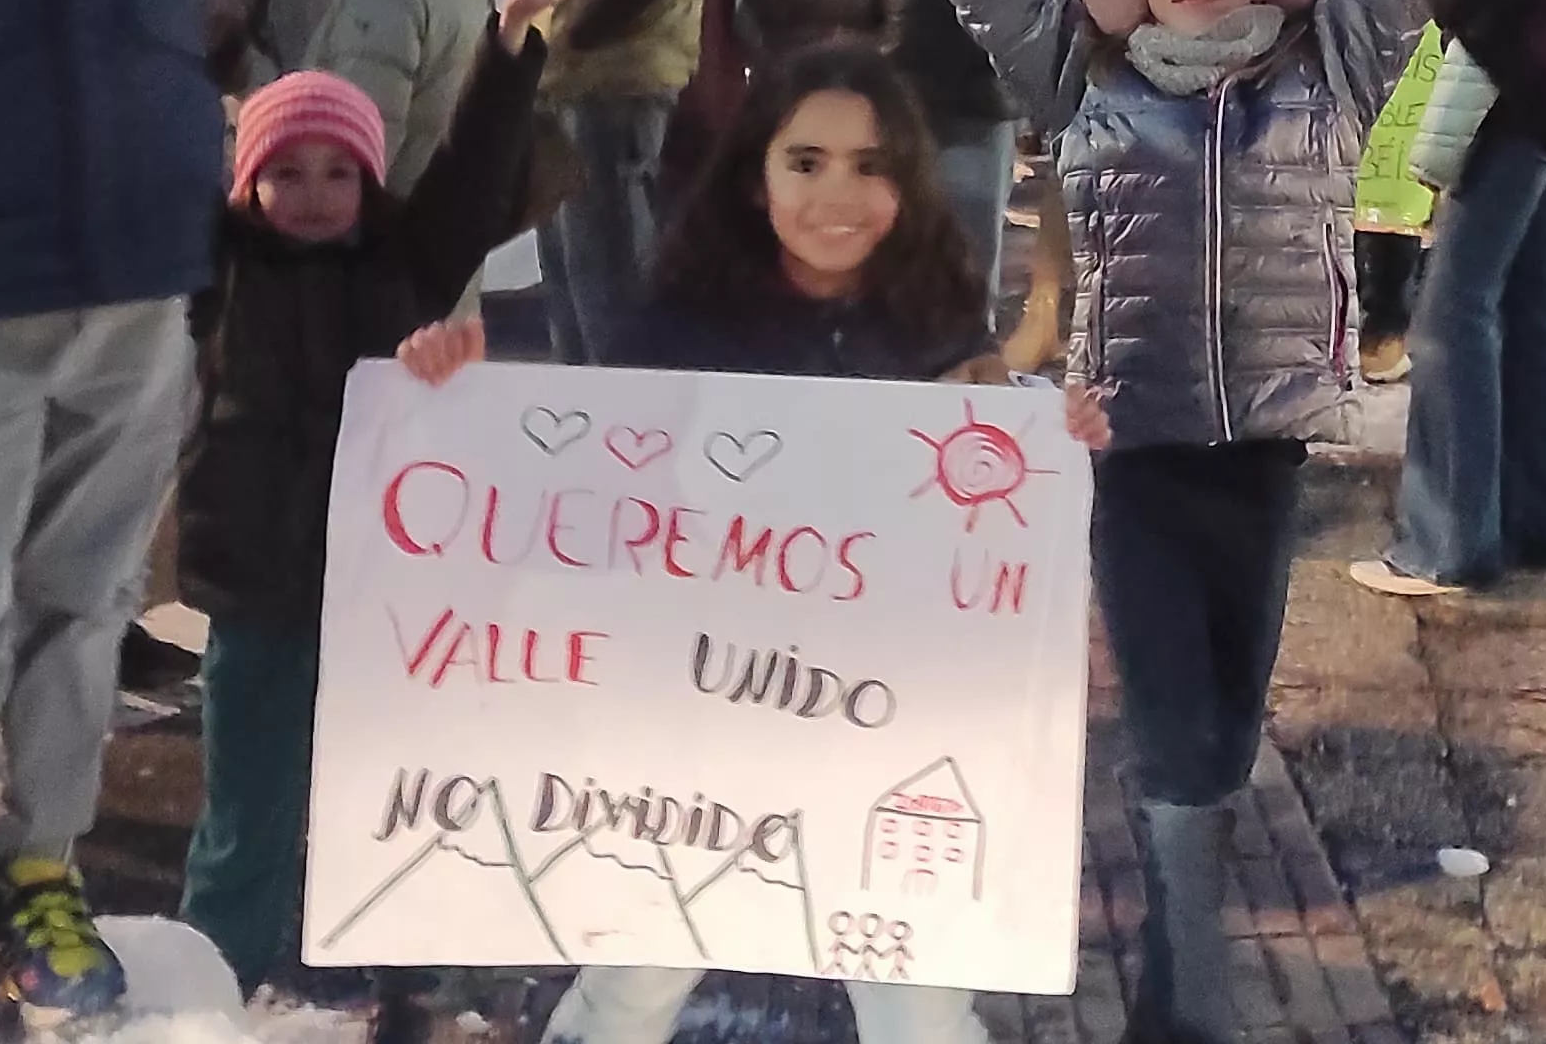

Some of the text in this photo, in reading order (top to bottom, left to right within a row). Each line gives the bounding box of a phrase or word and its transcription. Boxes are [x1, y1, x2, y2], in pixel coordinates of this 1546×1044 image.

[381, 459, 1030, 616] QUEREMOS UN
[390, 606, 896, 730] VALLE UNIDO
[372, 767, 480, 841] NO
